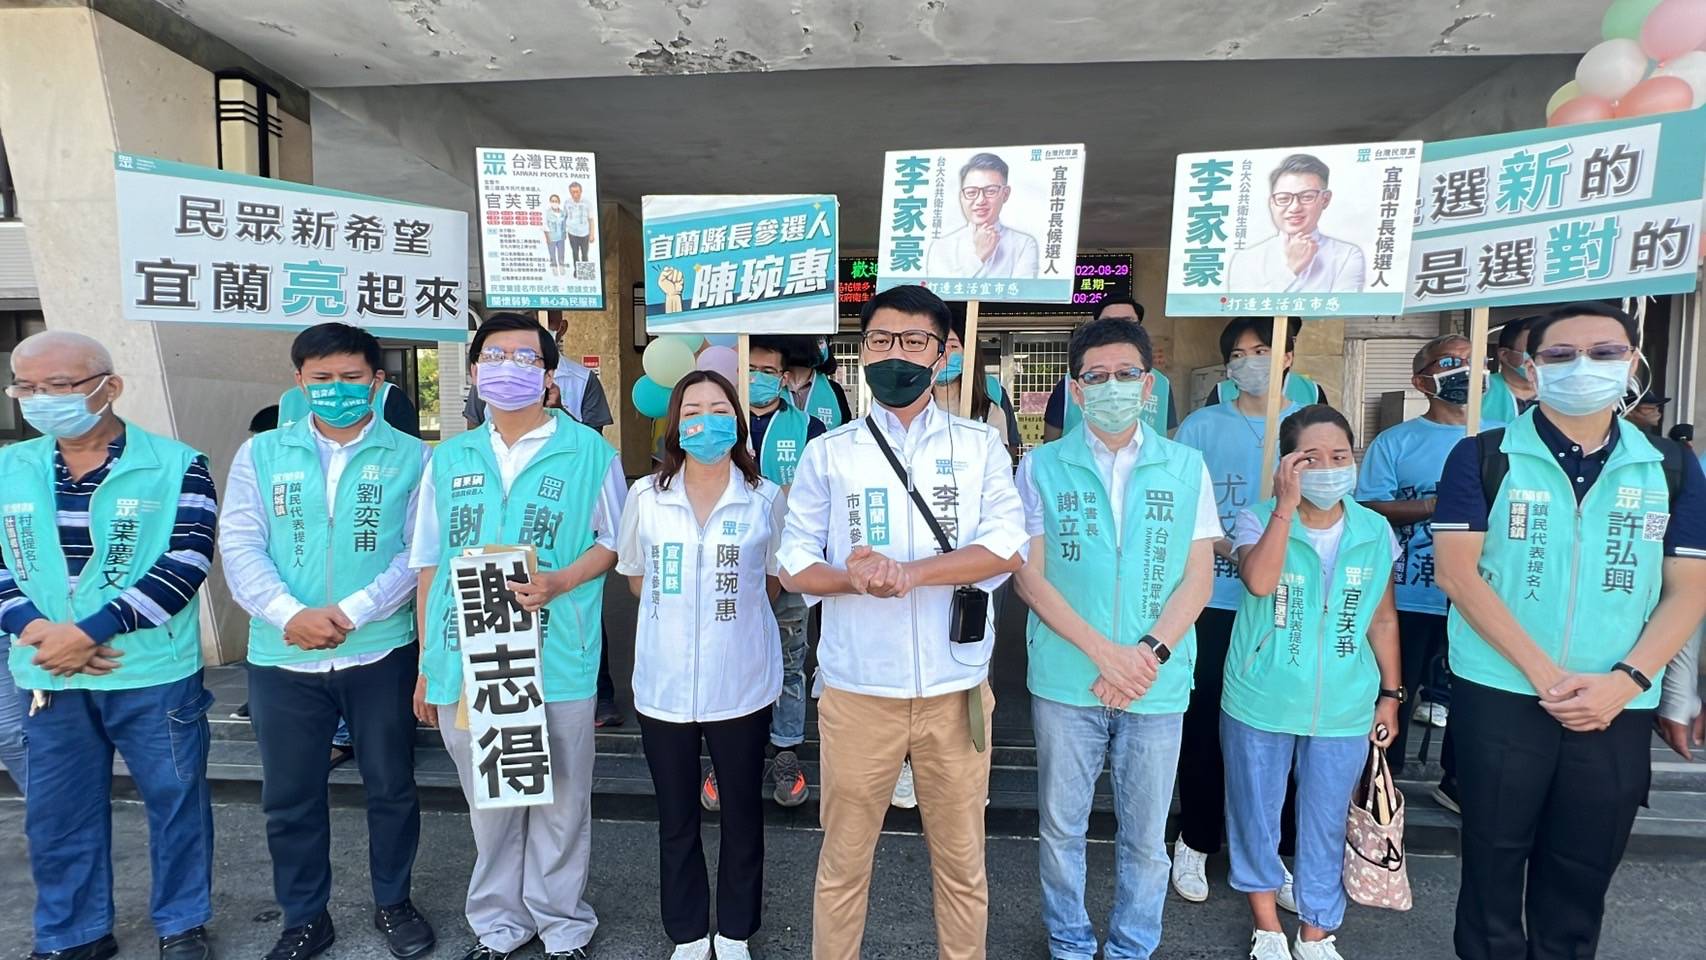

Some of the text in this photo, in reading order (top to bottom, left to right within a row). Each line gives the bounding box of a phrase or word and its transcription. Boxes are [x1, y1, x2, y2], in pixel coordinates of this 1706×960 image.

[483, 152, 507, 175] 眾
[512, 153, 590, 172] 台灣民眾黨
[512, 170, 539, 178] TAIWAN
[540, 171, 568, 179] PEOPLE'S
[932, 155, 946, 240] 台大公共衛生碩士
[1413, 143, 1641, 224] 選新的
[174, 195, 433, 256] 民眾新希望
[485, 193, 542, 209] 官芙爭
[647, 210, 831, 262] 宜蘭縣長參選人
[889, 156, 931, 272] 李家豪
[1044, 166, 1068, 275] 宜蘭市長候選人
[1182, 158, 1234, 288] 李家豪
[1234, 159, 1253, 250] 台大公共衛生碩士
[1371, 166, 1403, 288] 宜蘭市長候選人
[135, 258, 464, 319] 宜蘭亮起來
[691, 247, 832, 310] 陳琬惠
[1075, 264, 1129, 276] 022-08-29
[1080, 278, 1116, 290] 星期一
[1414, 216, 1694, 299] 是選對的
[1227, 296, 1341, 311] 打造生活宜市感
[289, 482, 305, 568] 鎮民代表提名人
[353, 482, 384, 552] 劉奕甫
[846, 494, 863, 551] 市長參
[868, 492, 886, 542] 宜蘭市
[933, 484, 959, 555] 李家
[1056, 491, 1080, 562] 謝立功
[1083, 491, 1098, 537] 秘書長
[1145, 489, 1174, 522] 眾
[99, 518, 138, 590] 葉慶文
[715, 543, 740, 622] 陳琬惠
[1148, 527, 1169, 619] 台灣民眾黨
[1524, 503, 1549, 602] 鎮民代表提名人
[1602, 511, 1643, 594] 許弘興
[1337, 587, 1362, 659] 官芙爭
[456, 561, 549, 799] 謝志得
